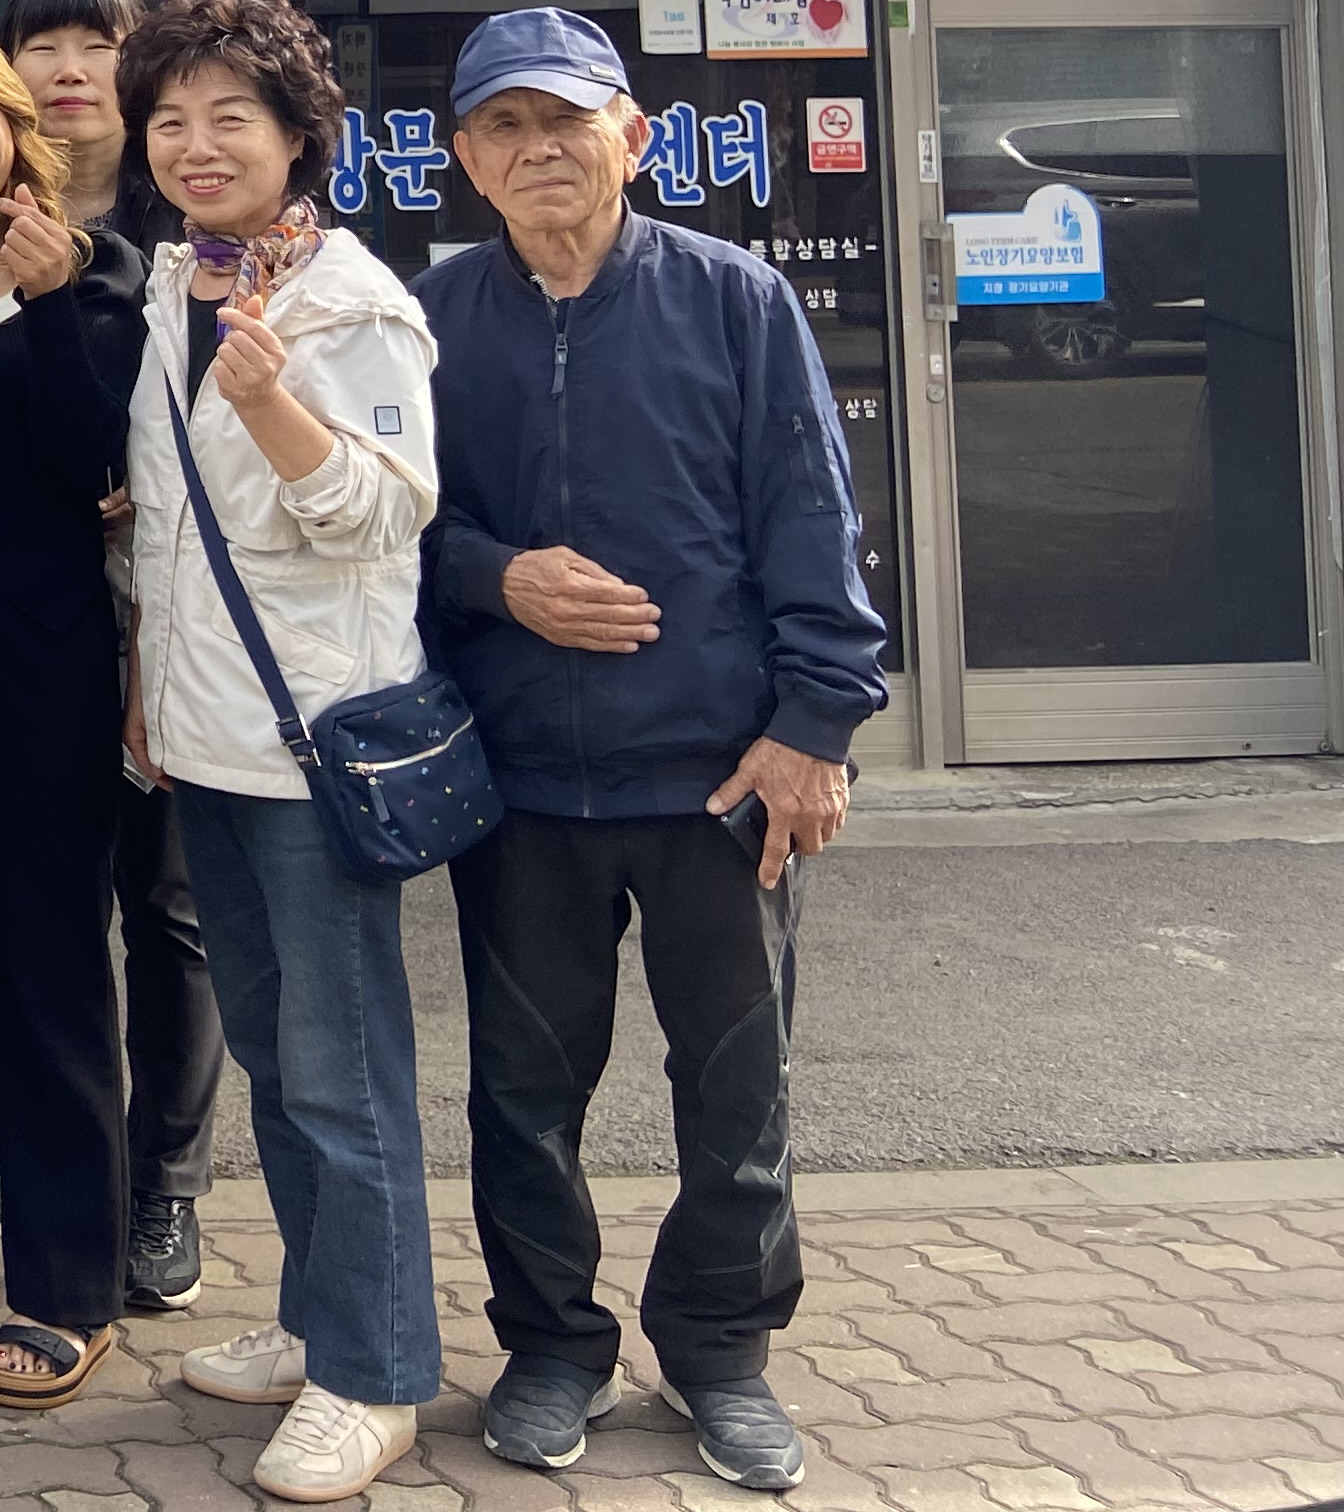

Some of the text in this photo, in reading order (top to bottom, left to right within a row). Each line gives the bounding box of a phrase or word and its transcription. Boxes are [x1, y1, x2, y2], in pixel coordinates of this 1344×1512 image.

[637, 99, 771, 208] 센터
[965, 245, 1084, 266] 노인장기요양보험
[805, 288, 838, 309] 상담
[845, 398, 878, 419] 상담
